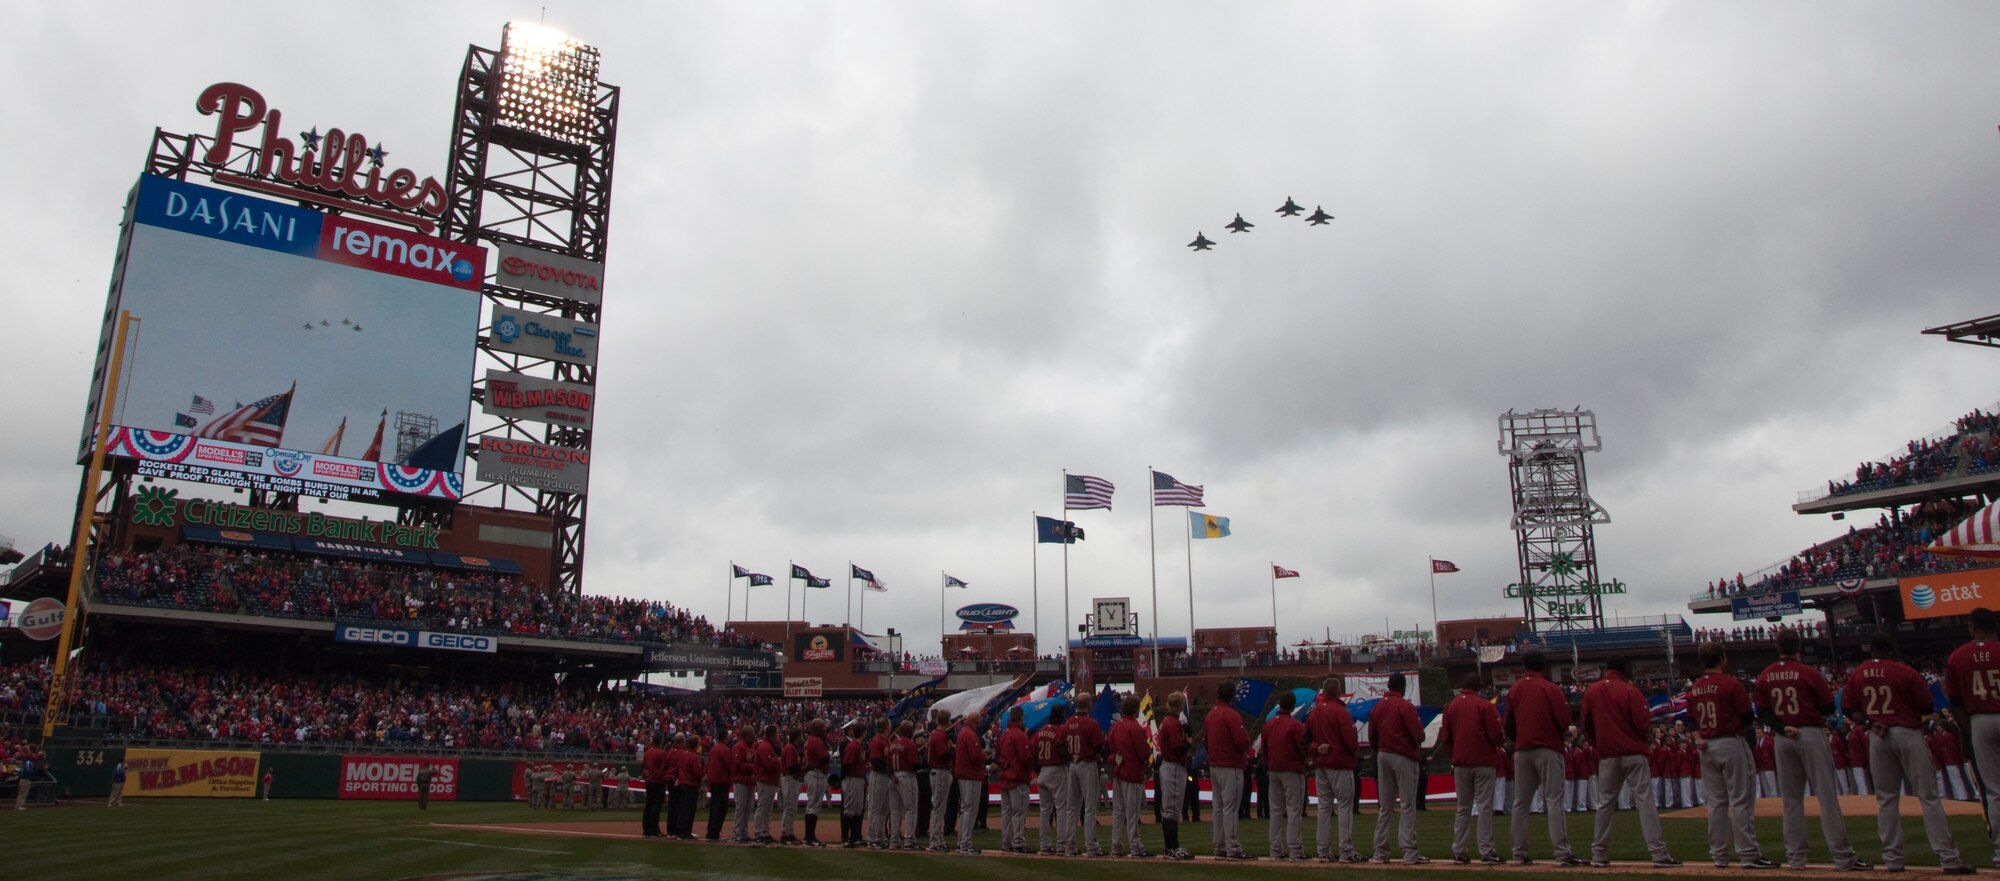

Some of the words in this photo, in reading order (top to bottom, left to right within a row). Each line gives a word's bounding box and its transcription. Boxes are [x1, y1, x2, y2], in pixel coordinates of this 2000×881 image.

[196, 82, 449, 217] Phillies
[166, 191, 296, 242] DASANI
[332, 225, 458, 274] remax
[527, 261, 599, 291] TOYOTA
[524, 321, 572, 343] Choose
[554, 340, 586, 358] Blue.
[197, 445, 244, 459] MODELL'S
[265, 447, 297, 461] Opening
[297, 450, 313, 463] Day
[481, 437, 589, 465] HORIZON
[315, 461, 358, 474] MODELL'S
[501, 454, 566, 471] SERVICES
[139, 459, 188, 472] ROCKETS'
[189, 464, 209, 475] RED
[211, 466, 245, 480] GLARE,
[247, 473, 266, 483] THE
[270, 476, 302, 487] BOMBS
[305, 480, 349, 493] BURSTING
[351, 486, 361, 495] IN
[363, 488, 380, 499] AIR,
[484, 472, 527, 484] HEATING
[536, 478, 580, 492] COOLING
[509, 466, 558, 480] PLUMBING
[138, 467, 165, 477] GAVE
[170, 471, 203, 481] PROOF
[205, 475, 251, 488] THROUGH
[253, 481, 271, 491] THE
[273, 484, 302, 494] NIGHT
[305, 487, 327, 497] THAT
[329, 491, 349, 500] OUR
[184, 498, 300, 534] Citizens
[306, 511, 376, 542] Bank
[380, 519, 439, 549] Park
[315, 540, 362, 552] HARRY
[1506, 583, 1576, 598] Citizens
[1580, 577, 1625, 595] Bank
[1940, 582, 1982, 602] at&t
[985, 607, 1015, 616] LIGHT
[1547, 599, 1587, 616] Park
[22, 610, 64, 628] Gulf
[344, 626, 410, 645] GEICO
[428, 633, 490, 650] GEICO
[1084, 638, 1142, 646] SHERWIN-WILLIAMS
[650, 651, 688, 663] Jefferson
[689, 653, 732, 667] University
[732, 656, 770, 669] Hospitals
[1973, 651, 1991, 663] LEE
[1765, 670, 1800, 683] JOHNSON
[1863, 668, 1886, 678] HALL
[1691, 684, 1719, 697] WALLACE
[1972, 669, 2000, 701] 45
[47, 673, 62, 724] 329
[1771, 686, 1800, 716] 23
[1862, 685, 1895, 715] 22
[1696, 701, 1718, 729] 29
[1038, 740, 1051, 760] 28
[1067, 735, 1081, 754] 30
[76, 750, 105, 766] 334
[138, 756, 258, 791] W.B.MASON
[345, 781, 408, 792] SPORTING
[410, 783, 454, 793] GODS
